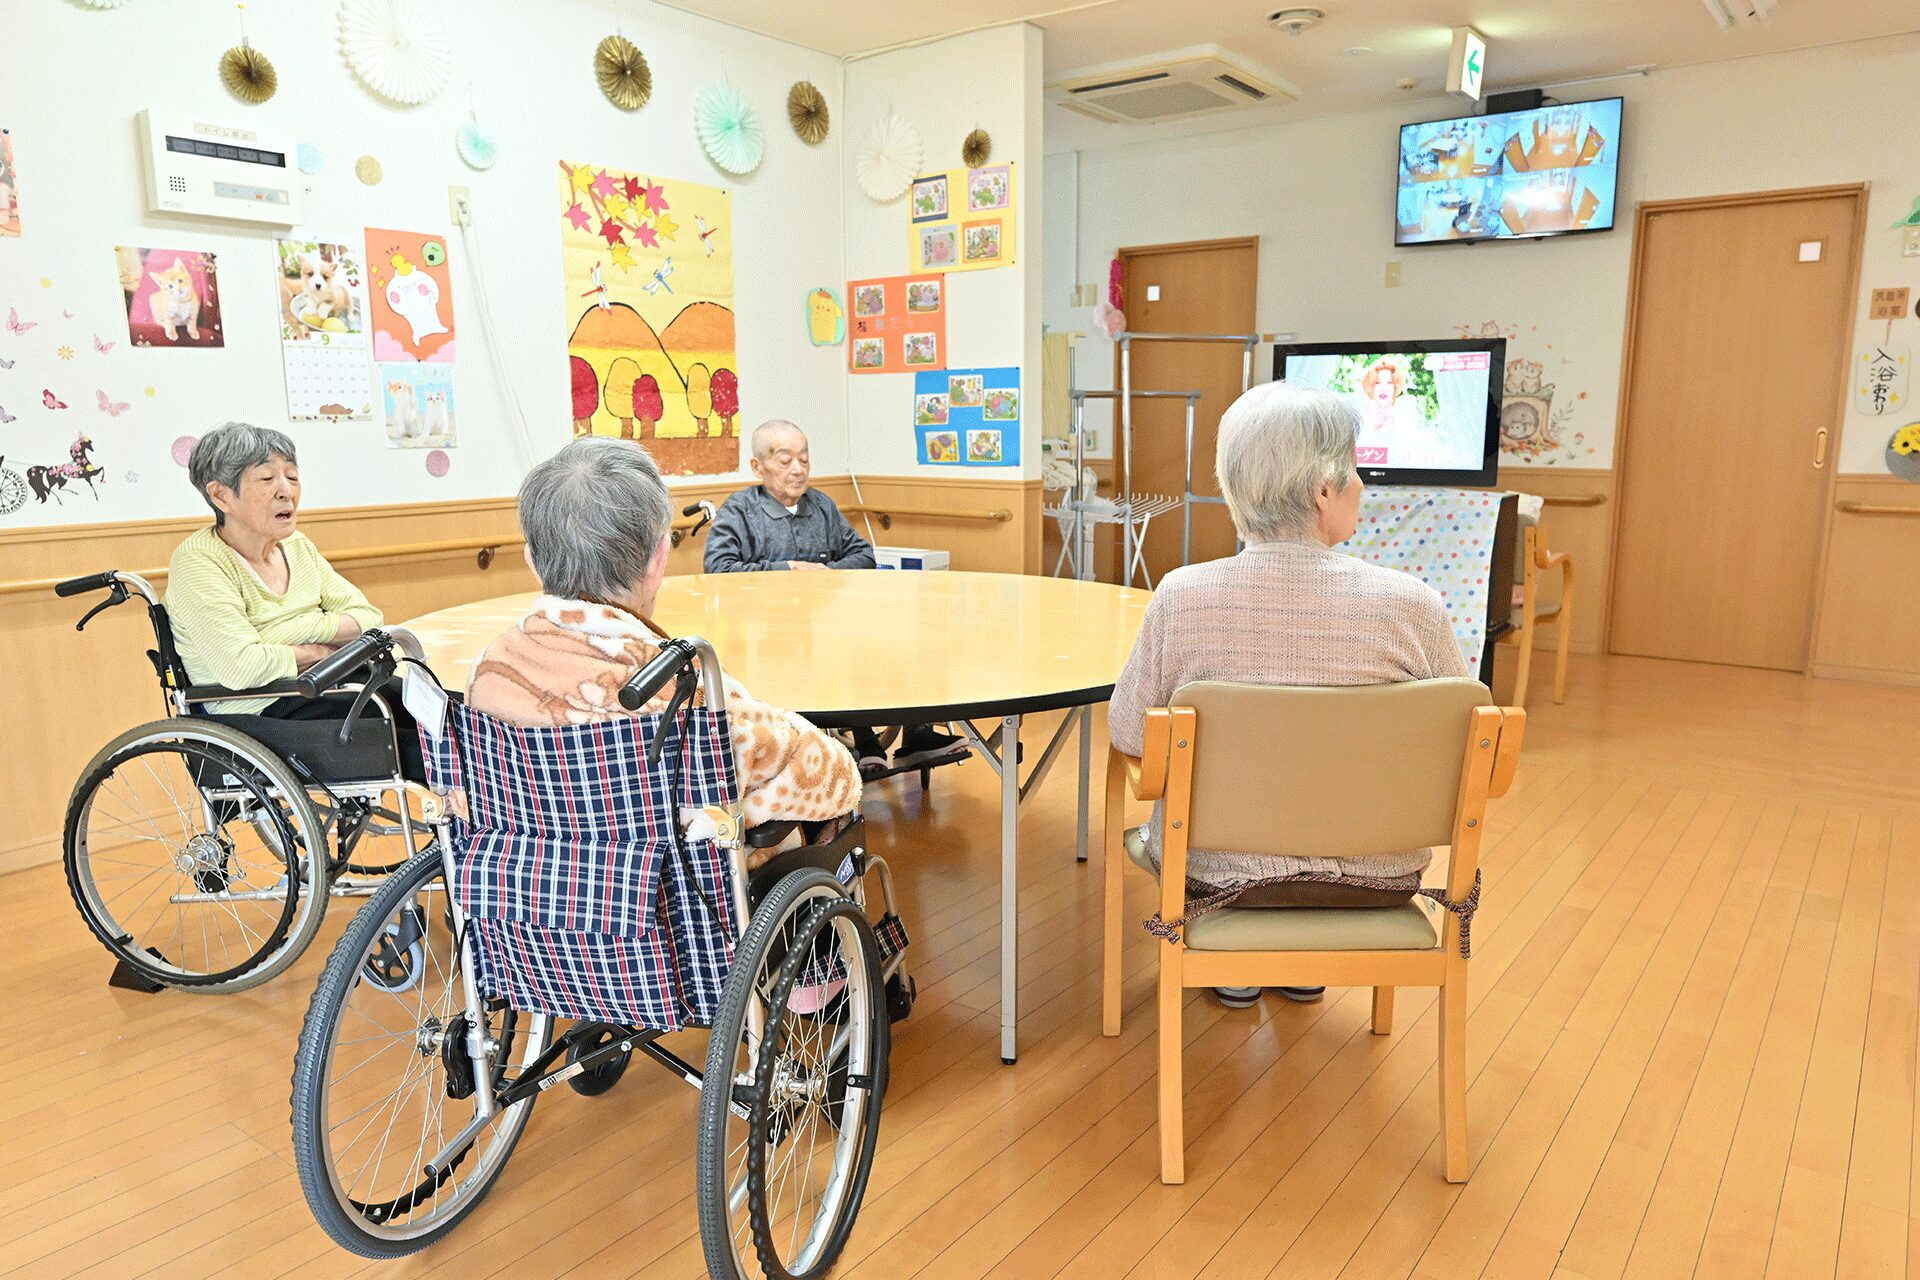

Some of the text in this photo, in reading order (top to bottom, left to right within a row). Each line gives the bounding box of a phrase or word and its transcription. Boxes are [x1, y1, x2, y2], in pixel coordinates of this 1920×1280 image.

[321, 334, 330, 345] 9
[1871, 347, 1897, 415] 入浴おわり
